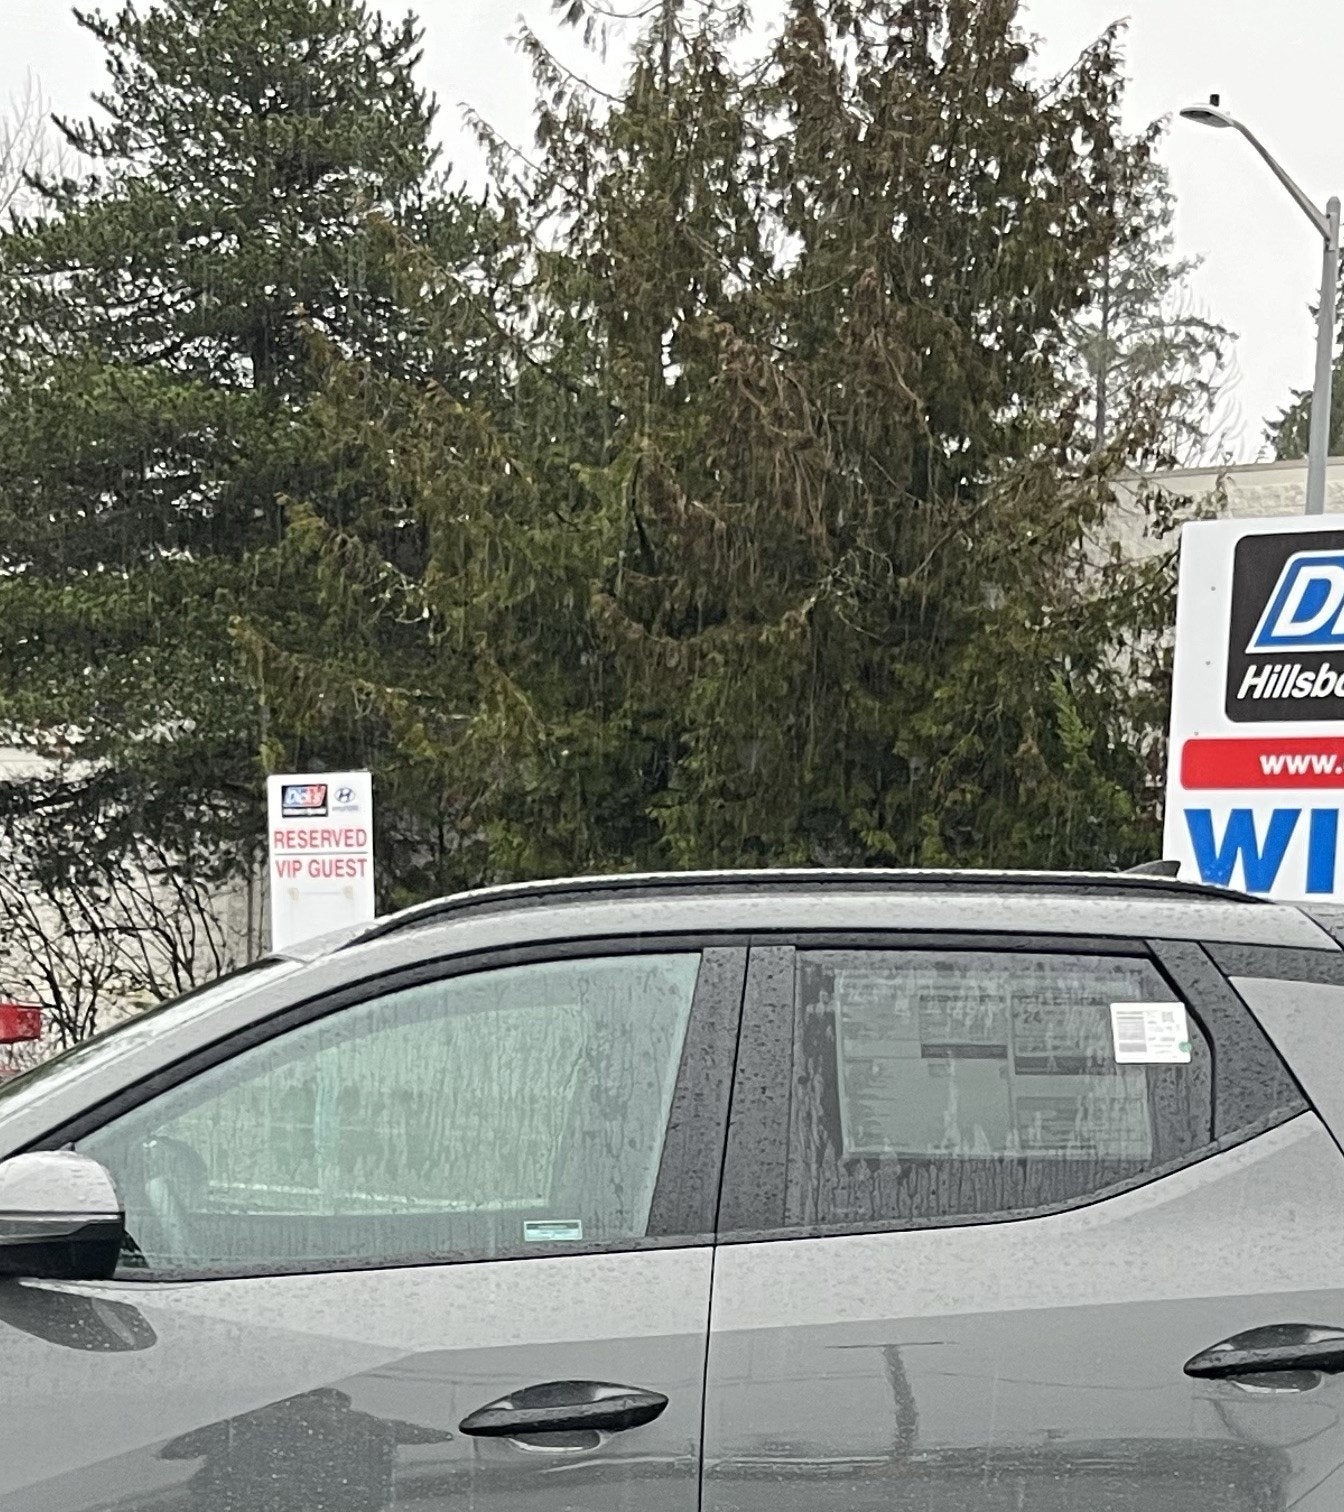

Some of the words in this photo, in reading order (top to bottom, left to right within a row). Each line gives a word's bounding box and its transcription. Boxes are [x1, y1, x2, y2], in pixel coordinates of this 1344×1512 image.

[274, 829, 367, 849] RESERVED
[275, 859, 302, 878] VIP
[308, 858, 367, 878] GUEST
